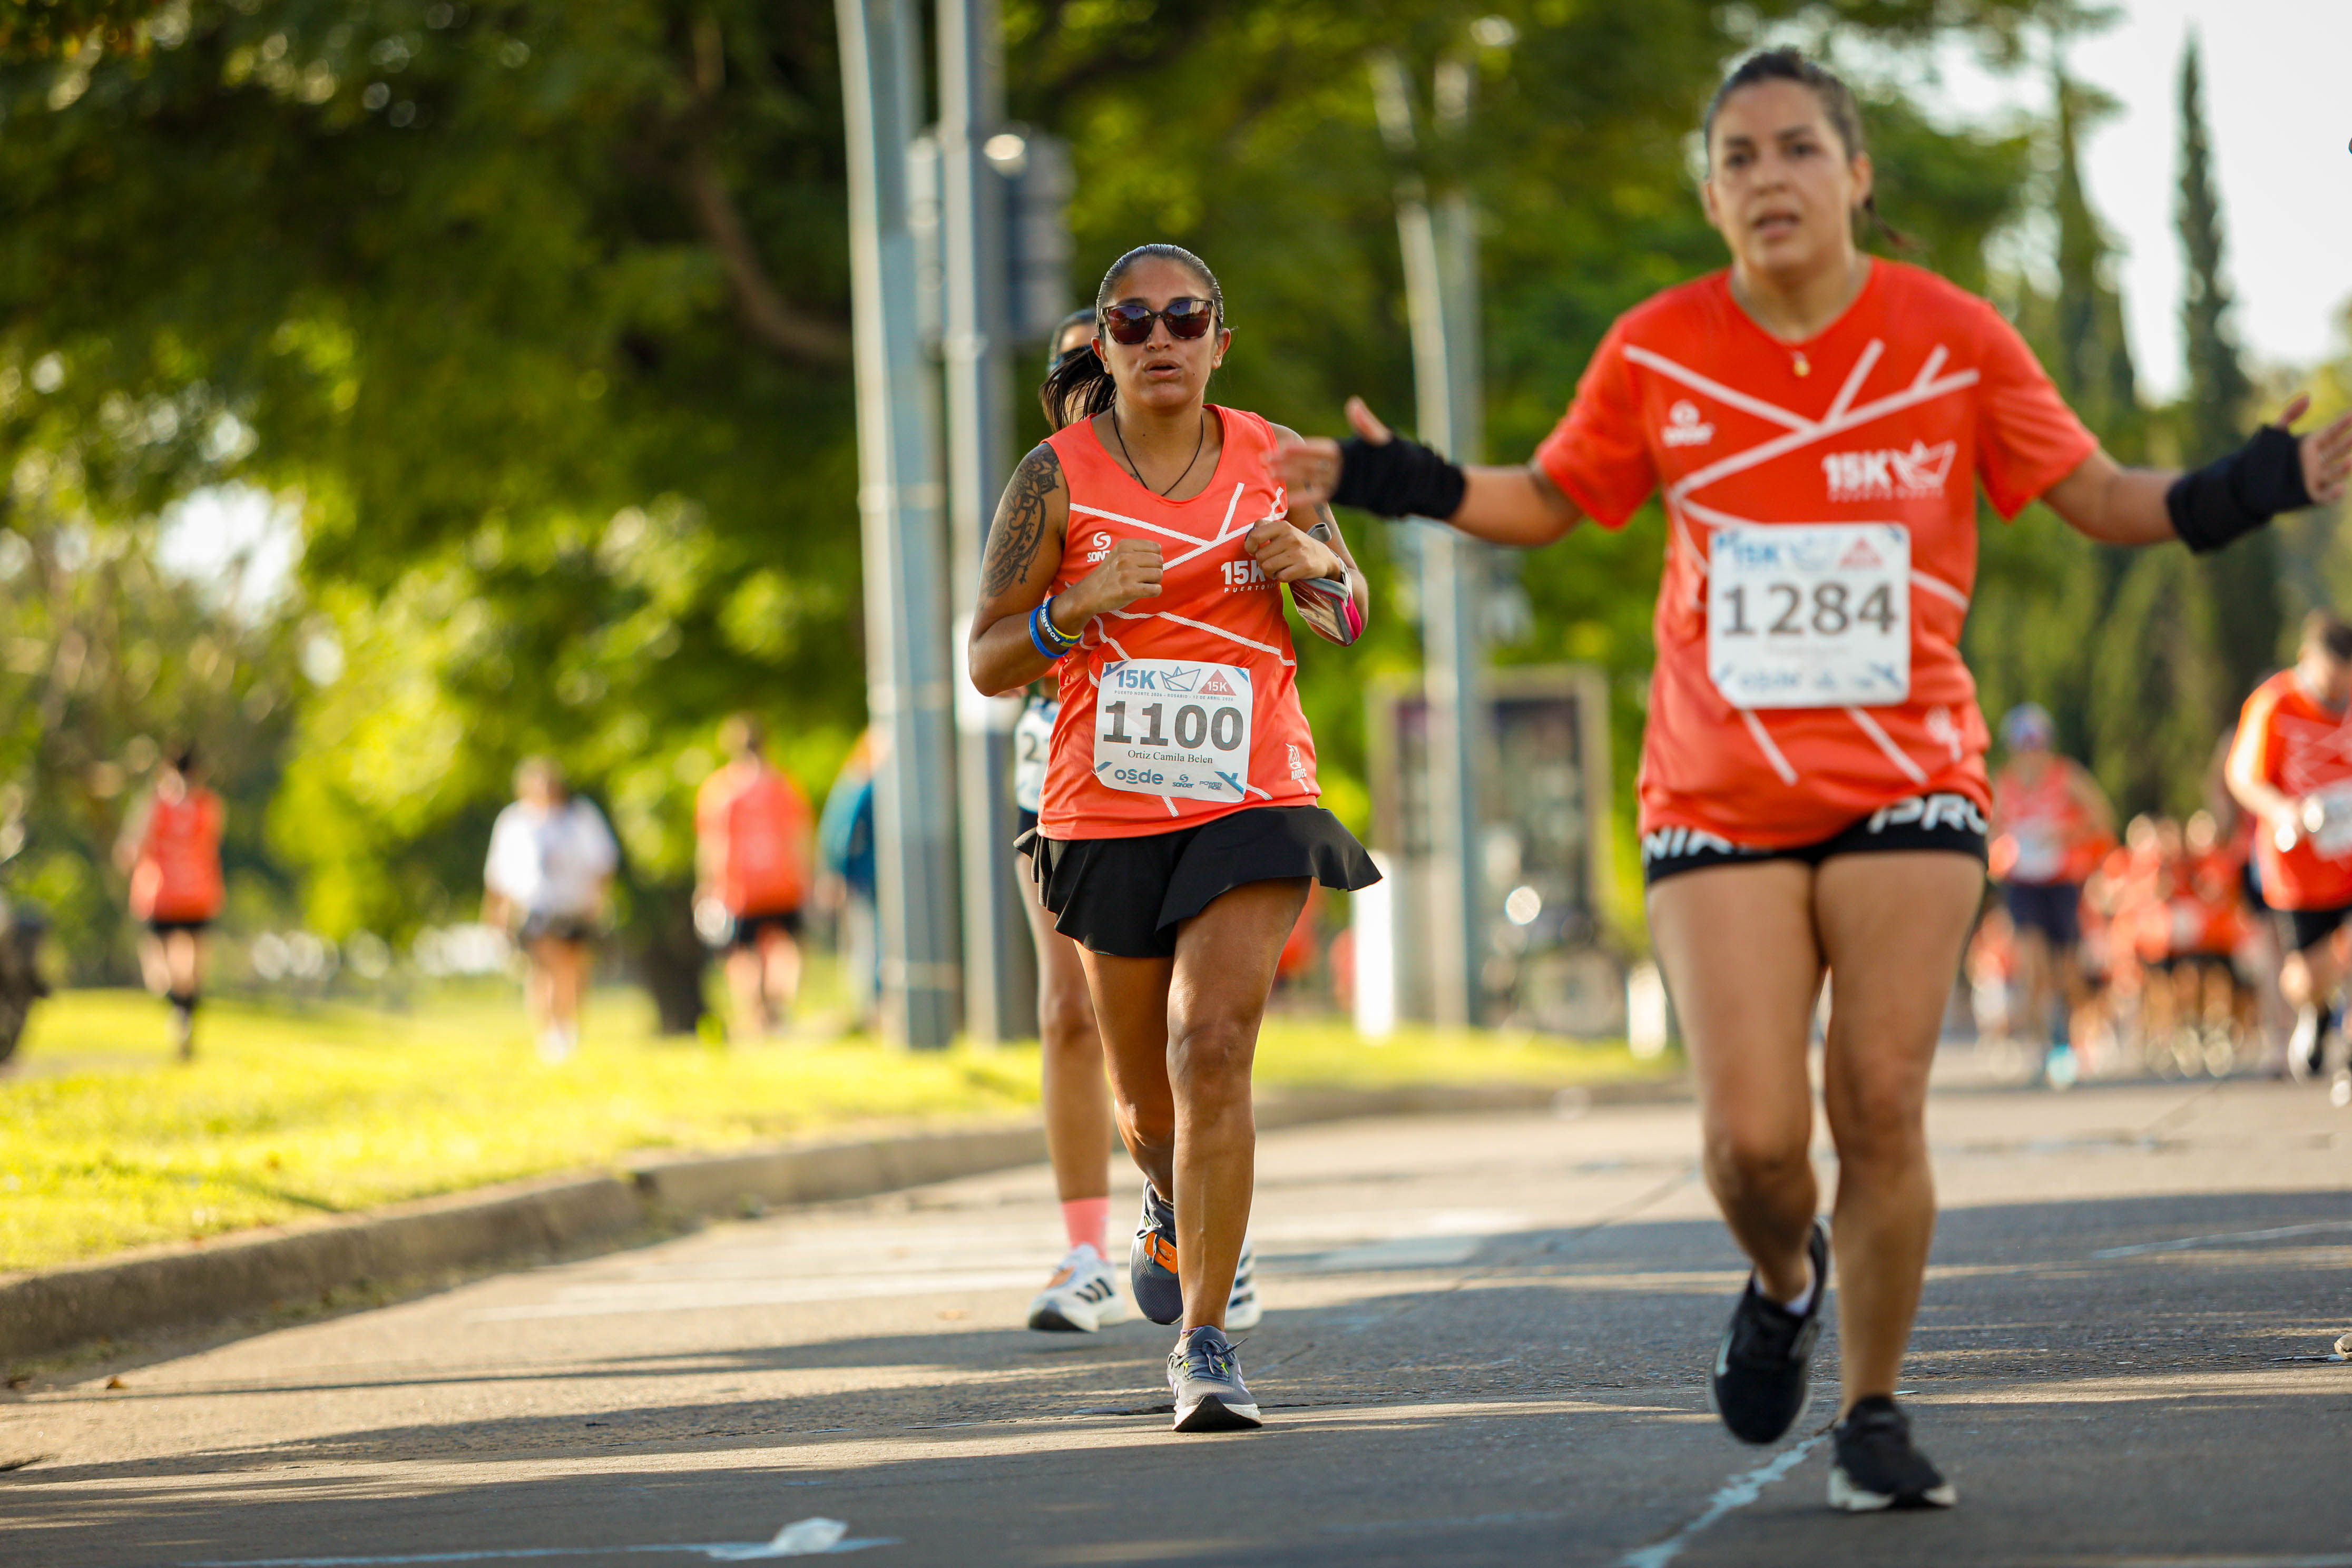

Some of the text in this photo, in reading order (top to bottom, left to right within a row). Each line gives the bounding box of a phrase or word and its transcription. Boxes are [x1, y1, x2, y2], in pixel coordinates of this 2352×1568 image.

[1821, 450, 1892, 489] 15K
[1221, 560, 1266, 585] 15K
[1224, 585, 1265, 593] PUERTO
[1722, 582, 1898, 637] 1284
[1042, 608, 1061, 642] ROSARIO
[1116, 669, 1157, 690] 15K
[1207, 681, 1227, 692] 15K
[1103, 701, 1243, 751] 1100
[1128, 750, 1213, 763] Ortiz Camila Belen
[1114, 769, 1164, 785] osde
